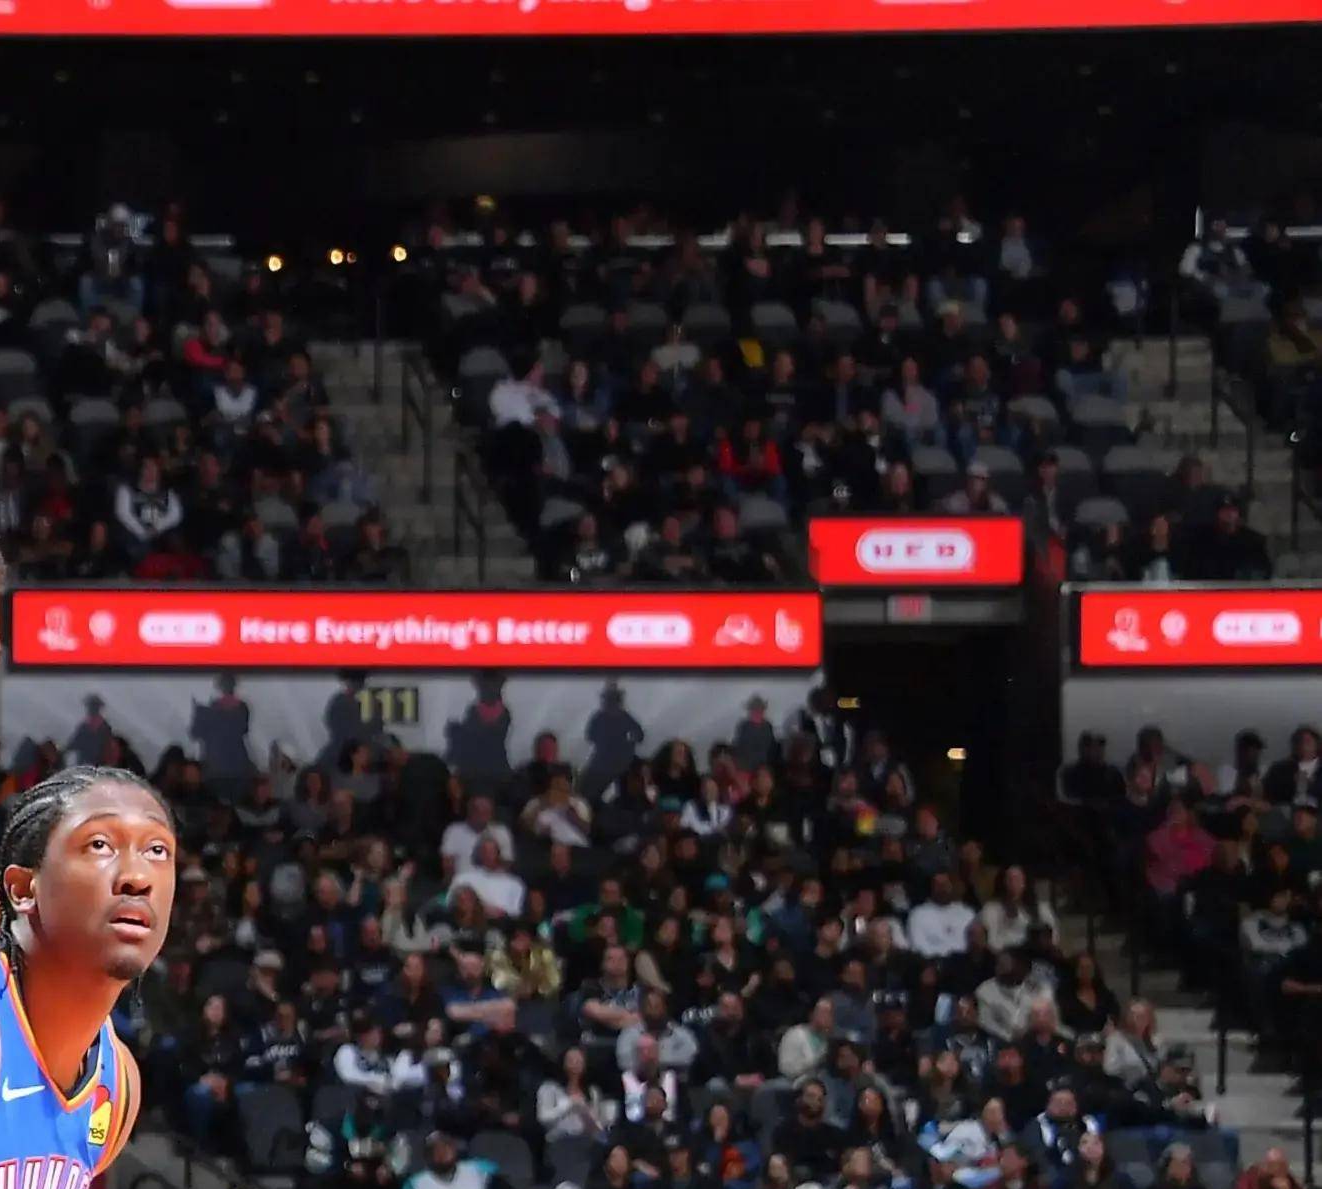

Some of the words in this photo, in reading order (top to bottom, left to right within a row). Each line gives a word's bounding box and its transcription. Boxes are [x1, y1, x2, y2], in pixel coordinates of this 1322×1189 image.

[239, 614, 310, 645] Here
[314, 613, 492, 651] Everything's
[496, 613, 593, 646] Better
[356, 688, 417, 722] 111
